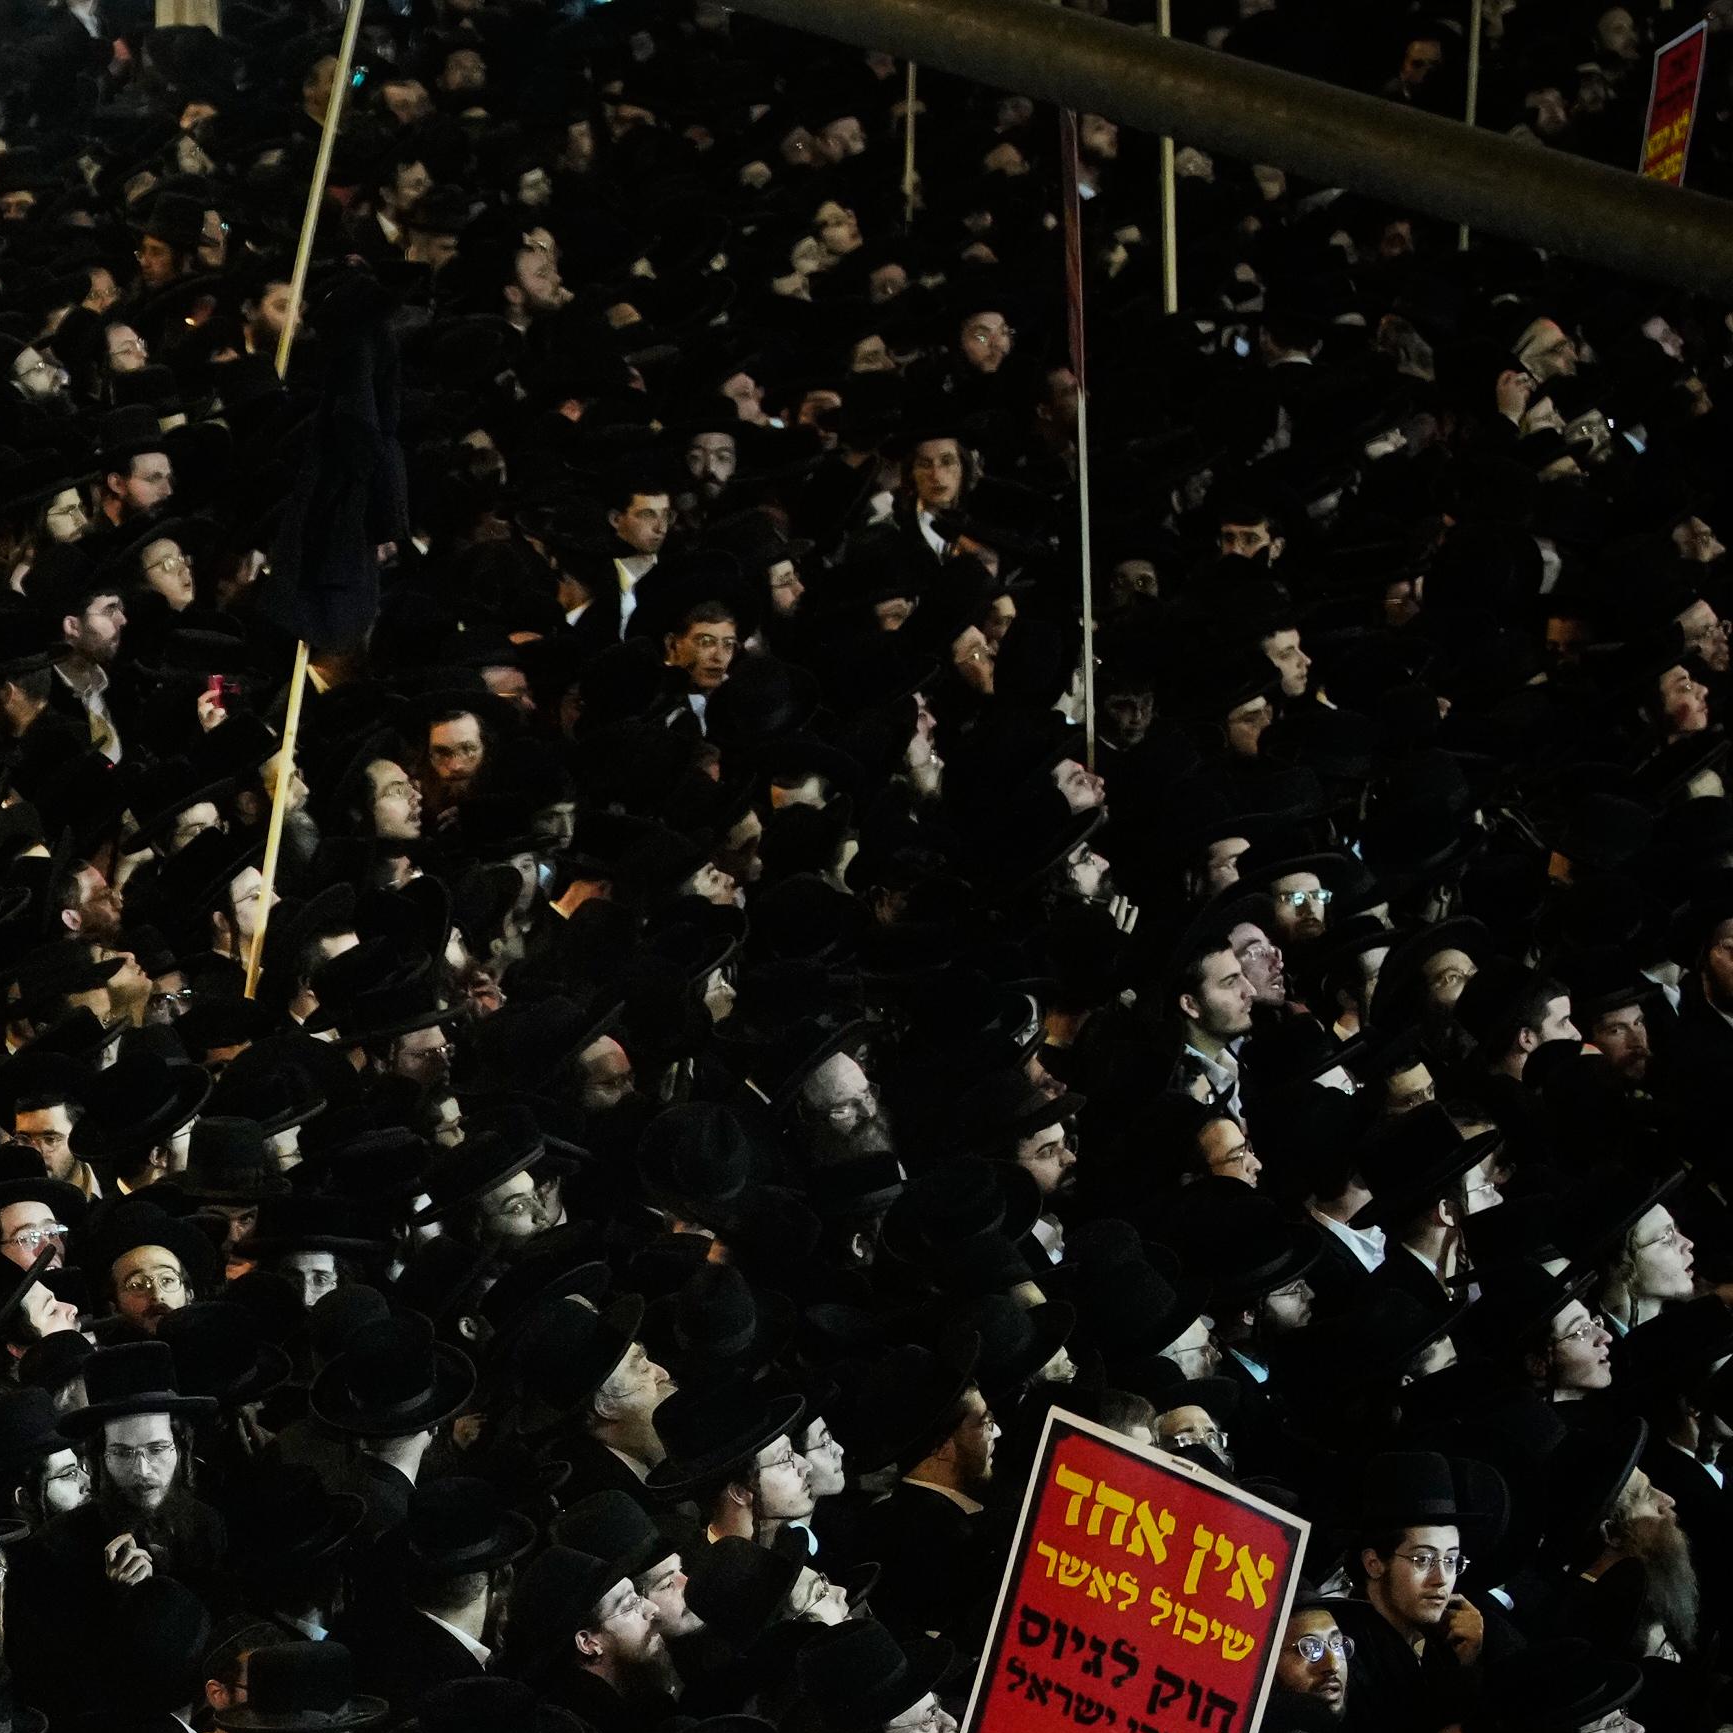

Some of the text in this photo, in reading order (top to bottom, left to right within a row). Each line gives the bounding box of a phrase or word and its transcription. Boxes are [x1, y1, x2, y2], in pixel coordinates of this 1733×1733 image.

[1055, 1463, 1275, 1610] אין אחד
[1016, 1603, 1140, 1688] לגיוס
[1037, 1540, 1256, 1662] שיכול לאשר
[1006, 1657, 1116, 1727] ישראל
